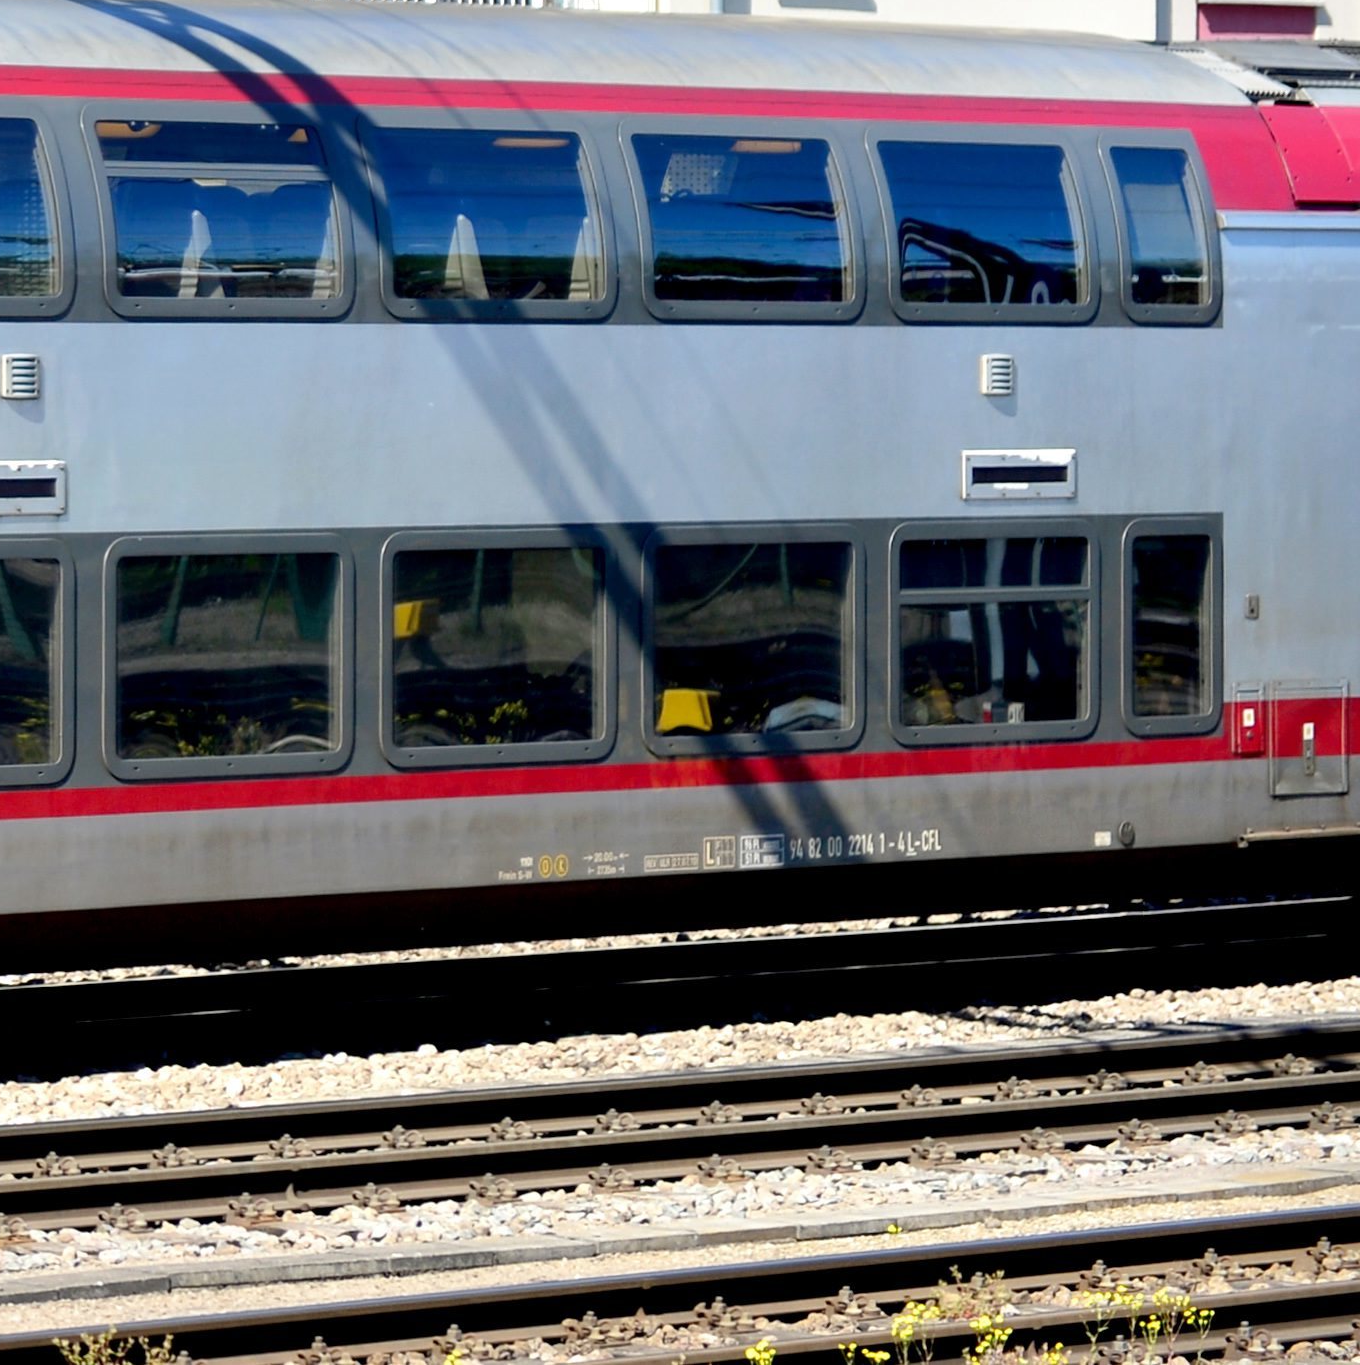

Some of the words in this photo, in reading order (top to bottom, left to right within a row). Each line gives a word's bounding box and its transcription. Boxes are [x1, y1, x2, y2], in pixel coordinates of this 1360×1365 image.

[789, 837, 804, 859] 94
[808, 836, 822, 858] 82
[827, 835, 843, 857] 00
[848, 833, 874, 856] 2214
